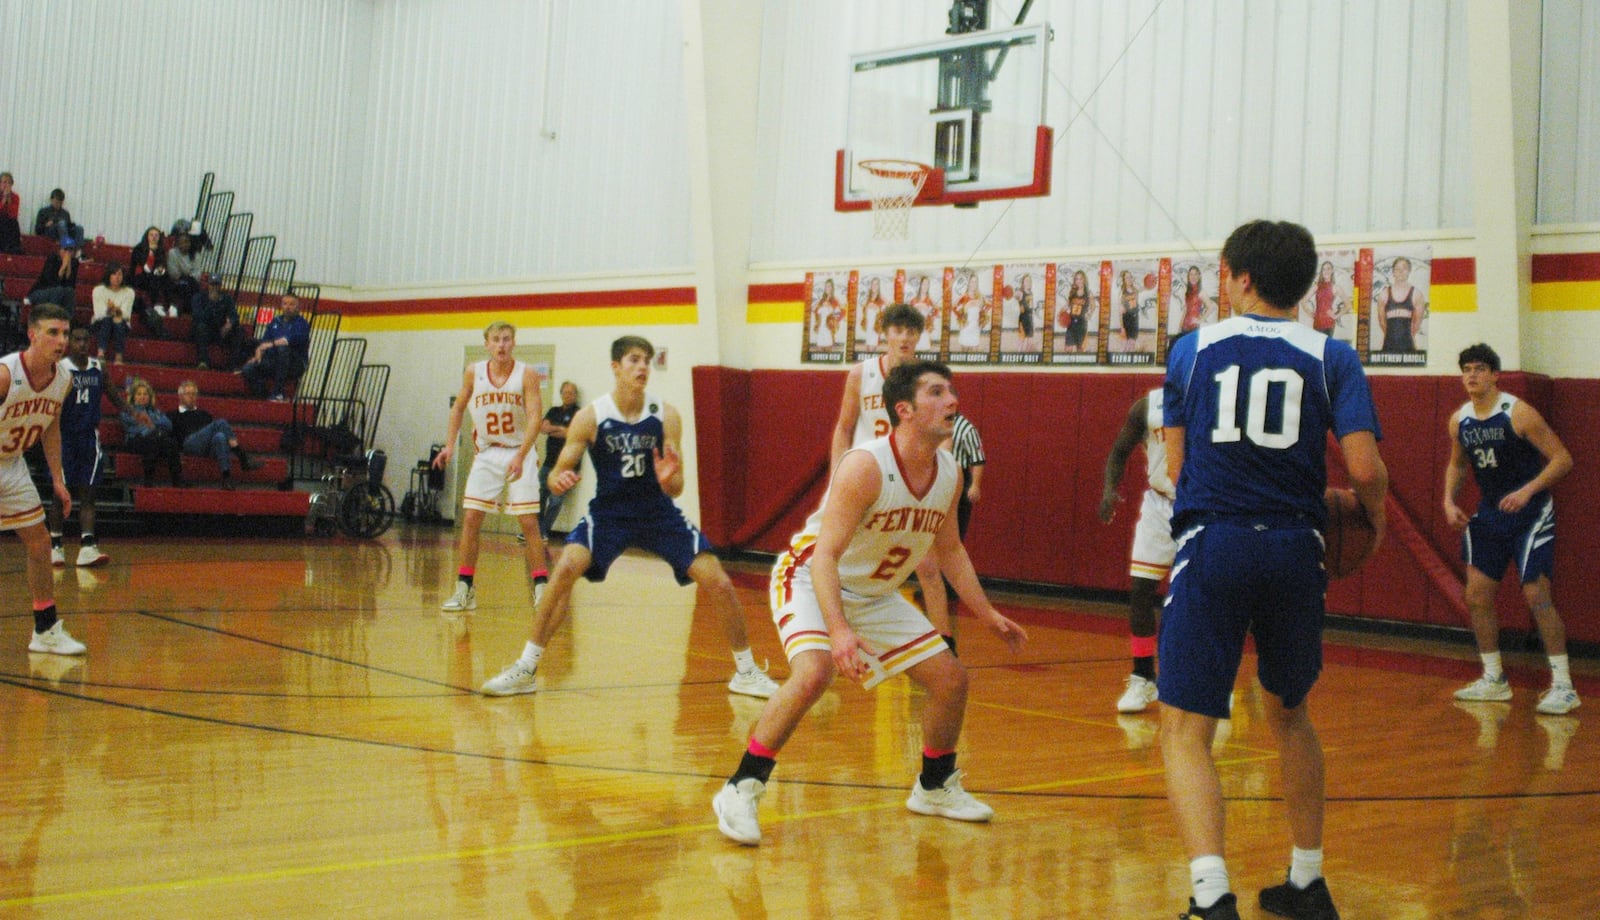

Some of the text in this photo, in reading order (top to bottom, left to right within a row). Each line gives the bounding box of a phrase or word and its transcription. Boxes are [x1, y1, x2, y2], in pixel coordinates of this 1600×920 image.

[76, 388, 89, 404] 14
[475, 391, 523, 408] FENWICK
[1211, 364, 1305, 450] 10
[486, 411, 515, 436] 22
[2, 425, 43, 453] 30
[621, 453, 646, 478] 20
[1474, 447, 1498, 468] 34
[864, 507, 945, 534] FENWICK
[870, 546, 911, 581] 2
